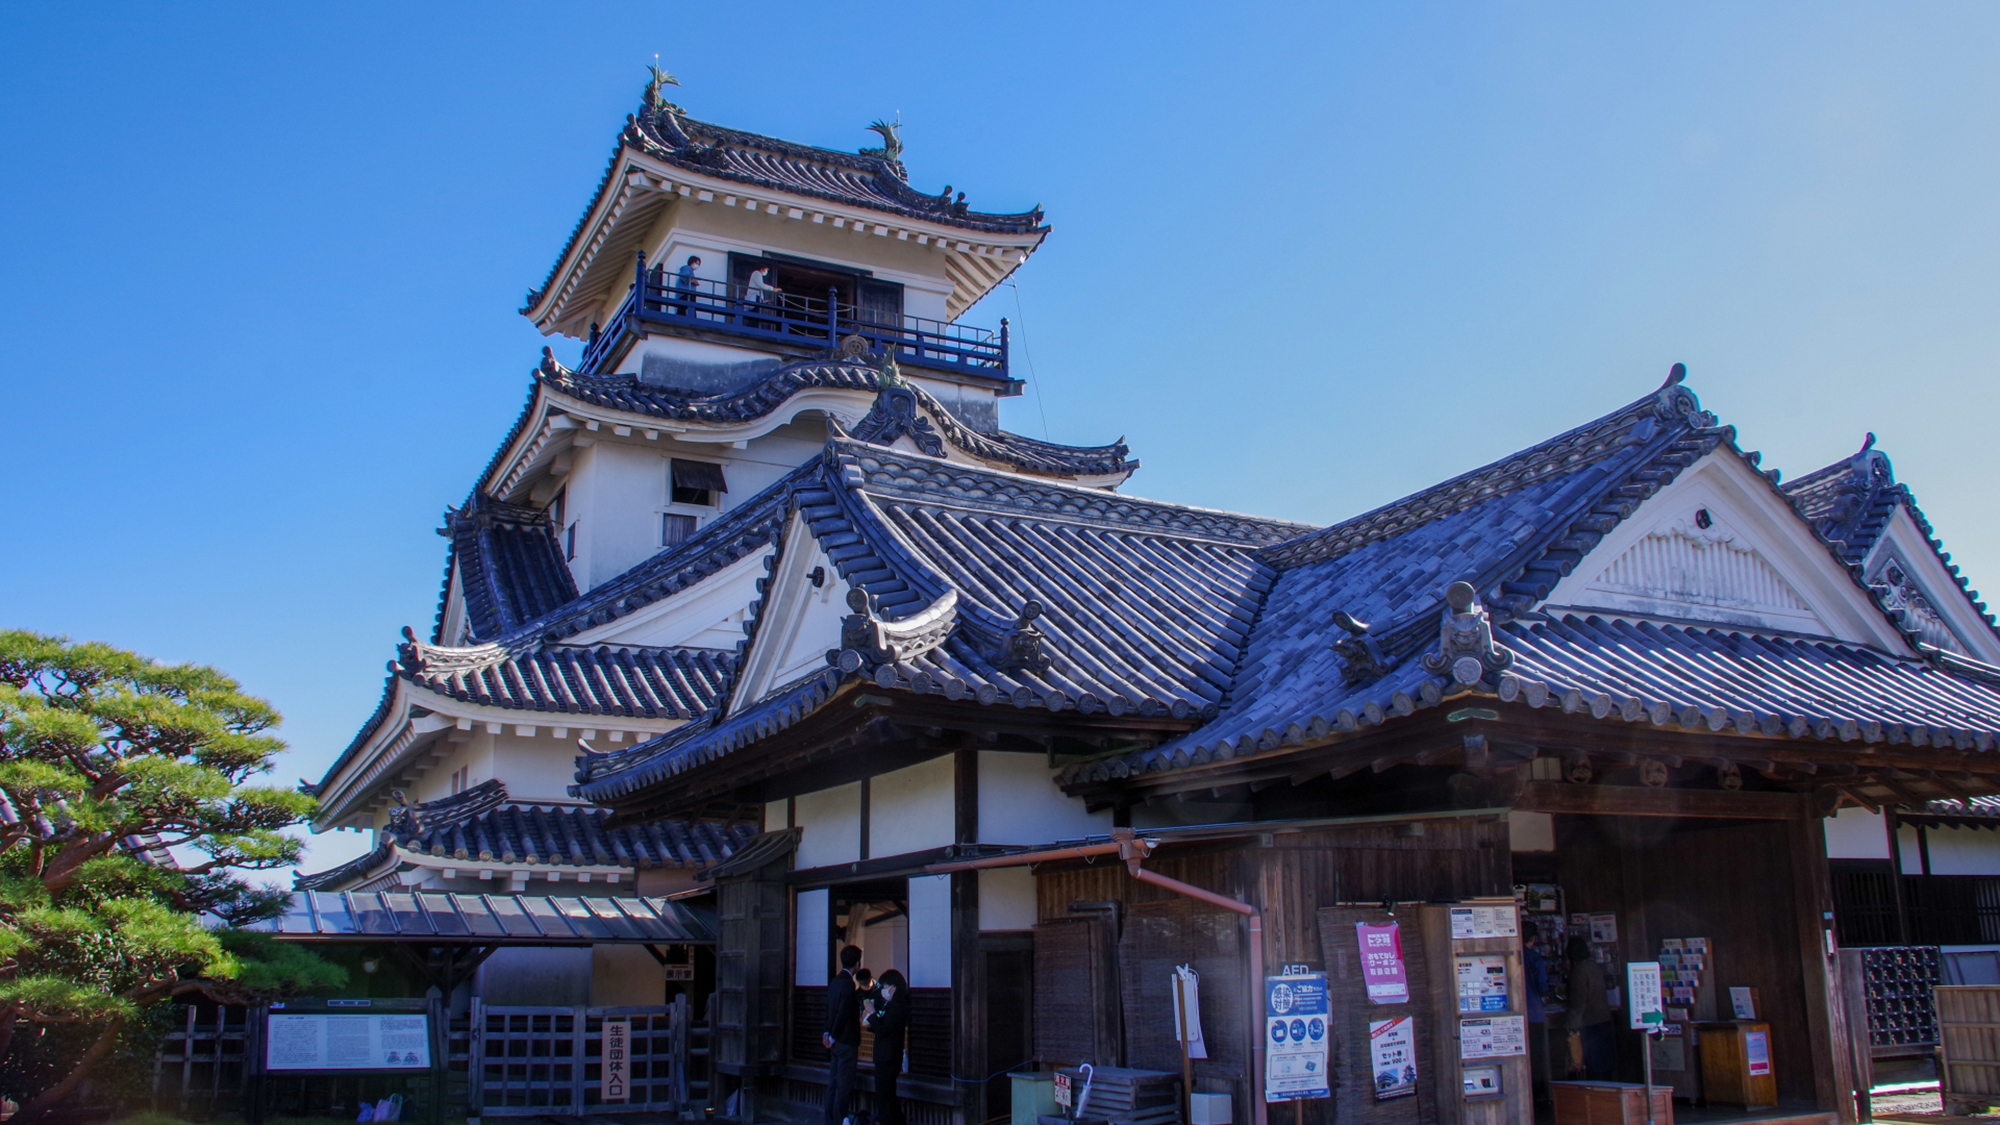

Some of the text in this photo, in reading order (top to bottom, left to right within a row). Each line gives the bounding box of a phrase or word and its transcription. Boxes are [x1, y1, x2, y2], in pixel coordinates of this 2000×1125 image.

[1368, 952, 1395, 960] おもてなし
[1369, 959, 1396, 967] クーポン
[666, 969, 692, 979] 展示室
[1282, 964, 1309, 976] AED
[1381, 1050, 1402, 1059] セット券
[609, 1025, 624, 1096] 生徒団体入口
